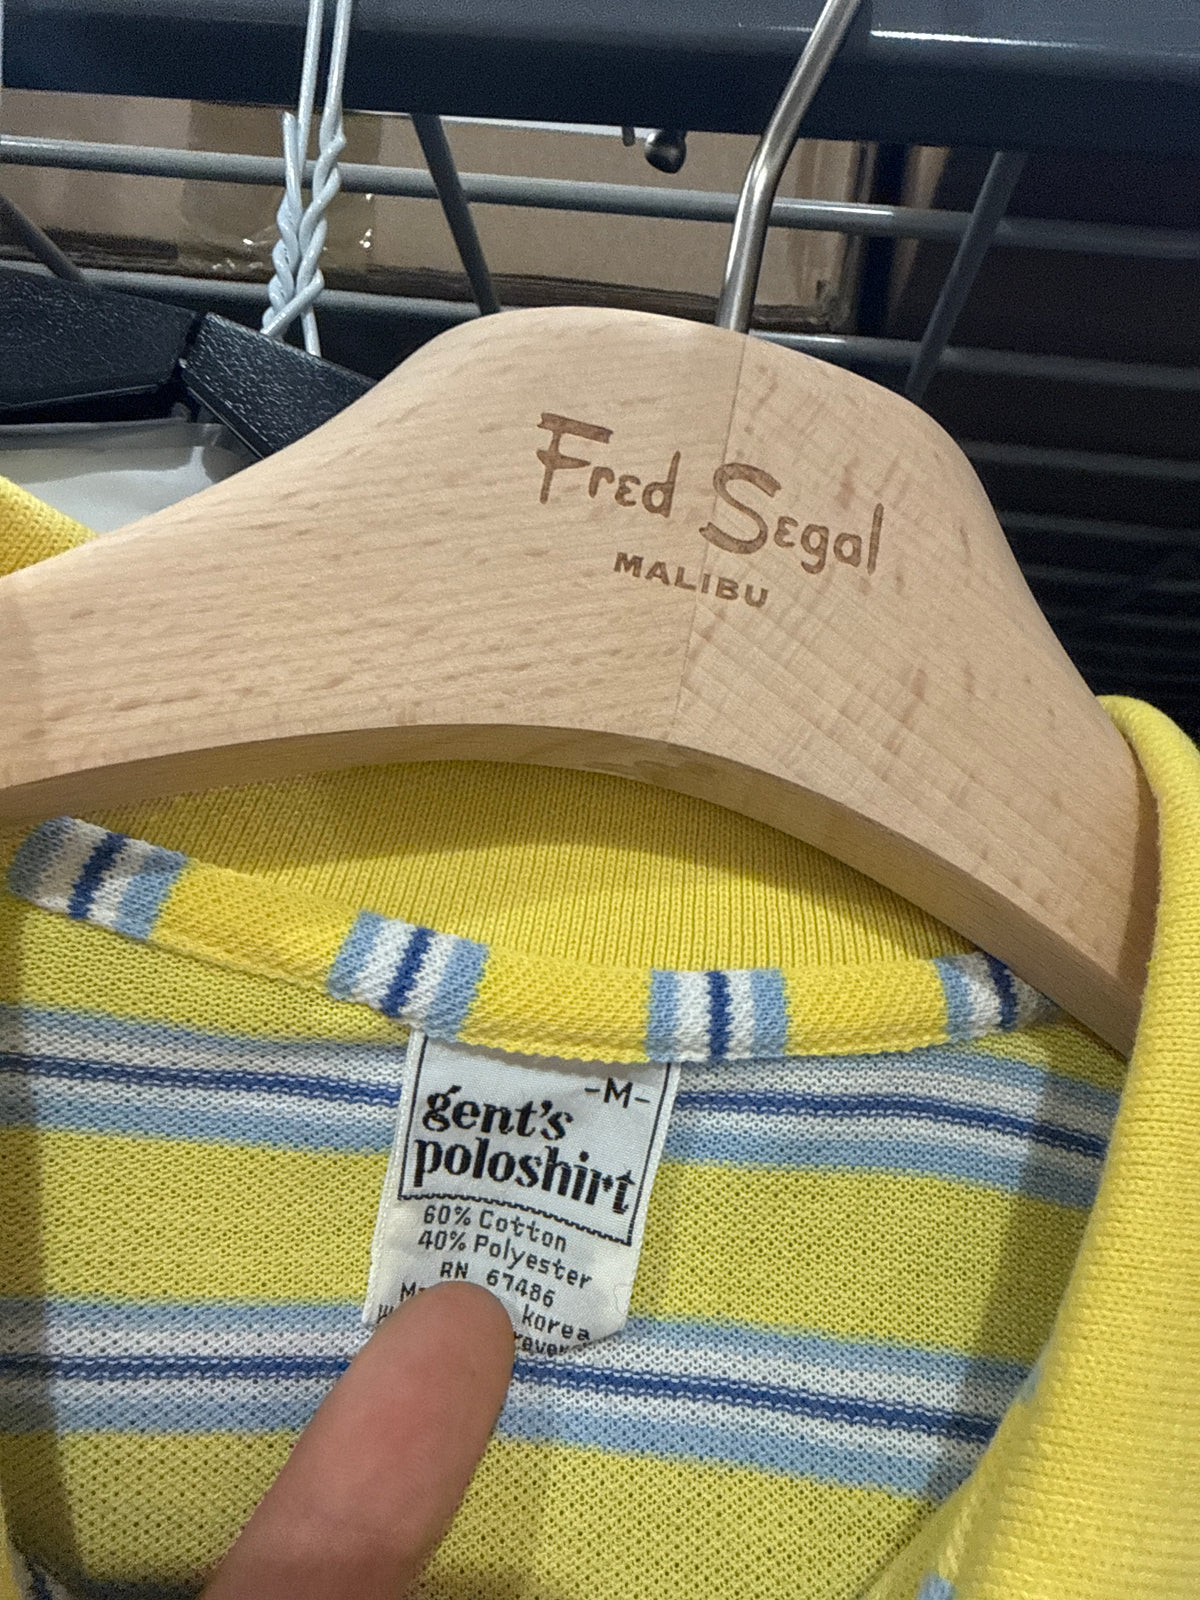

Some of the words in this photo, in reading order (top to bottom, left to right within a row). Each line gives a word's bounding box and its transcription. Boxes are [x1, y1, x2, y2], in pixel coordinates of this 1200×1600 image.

[536, 411, 682, 519] Fred
[698, 461, 885, 577] Segal
[613, 551, 770, 609] MALIBU
[421, 1084, 575, 1142] gent's
[412, 1136, 637, 1216] poloshirt
[423, 1204, 472, 1227] 60%
[478, 1208, 567, 1253] Cotton
[417, 1229, 467, 1252] 40%
[473, 1233, 593, 1290] Polyester
[439, 1260, 470, 1280] RN
[485, 1268, 557, 1309] 67486
